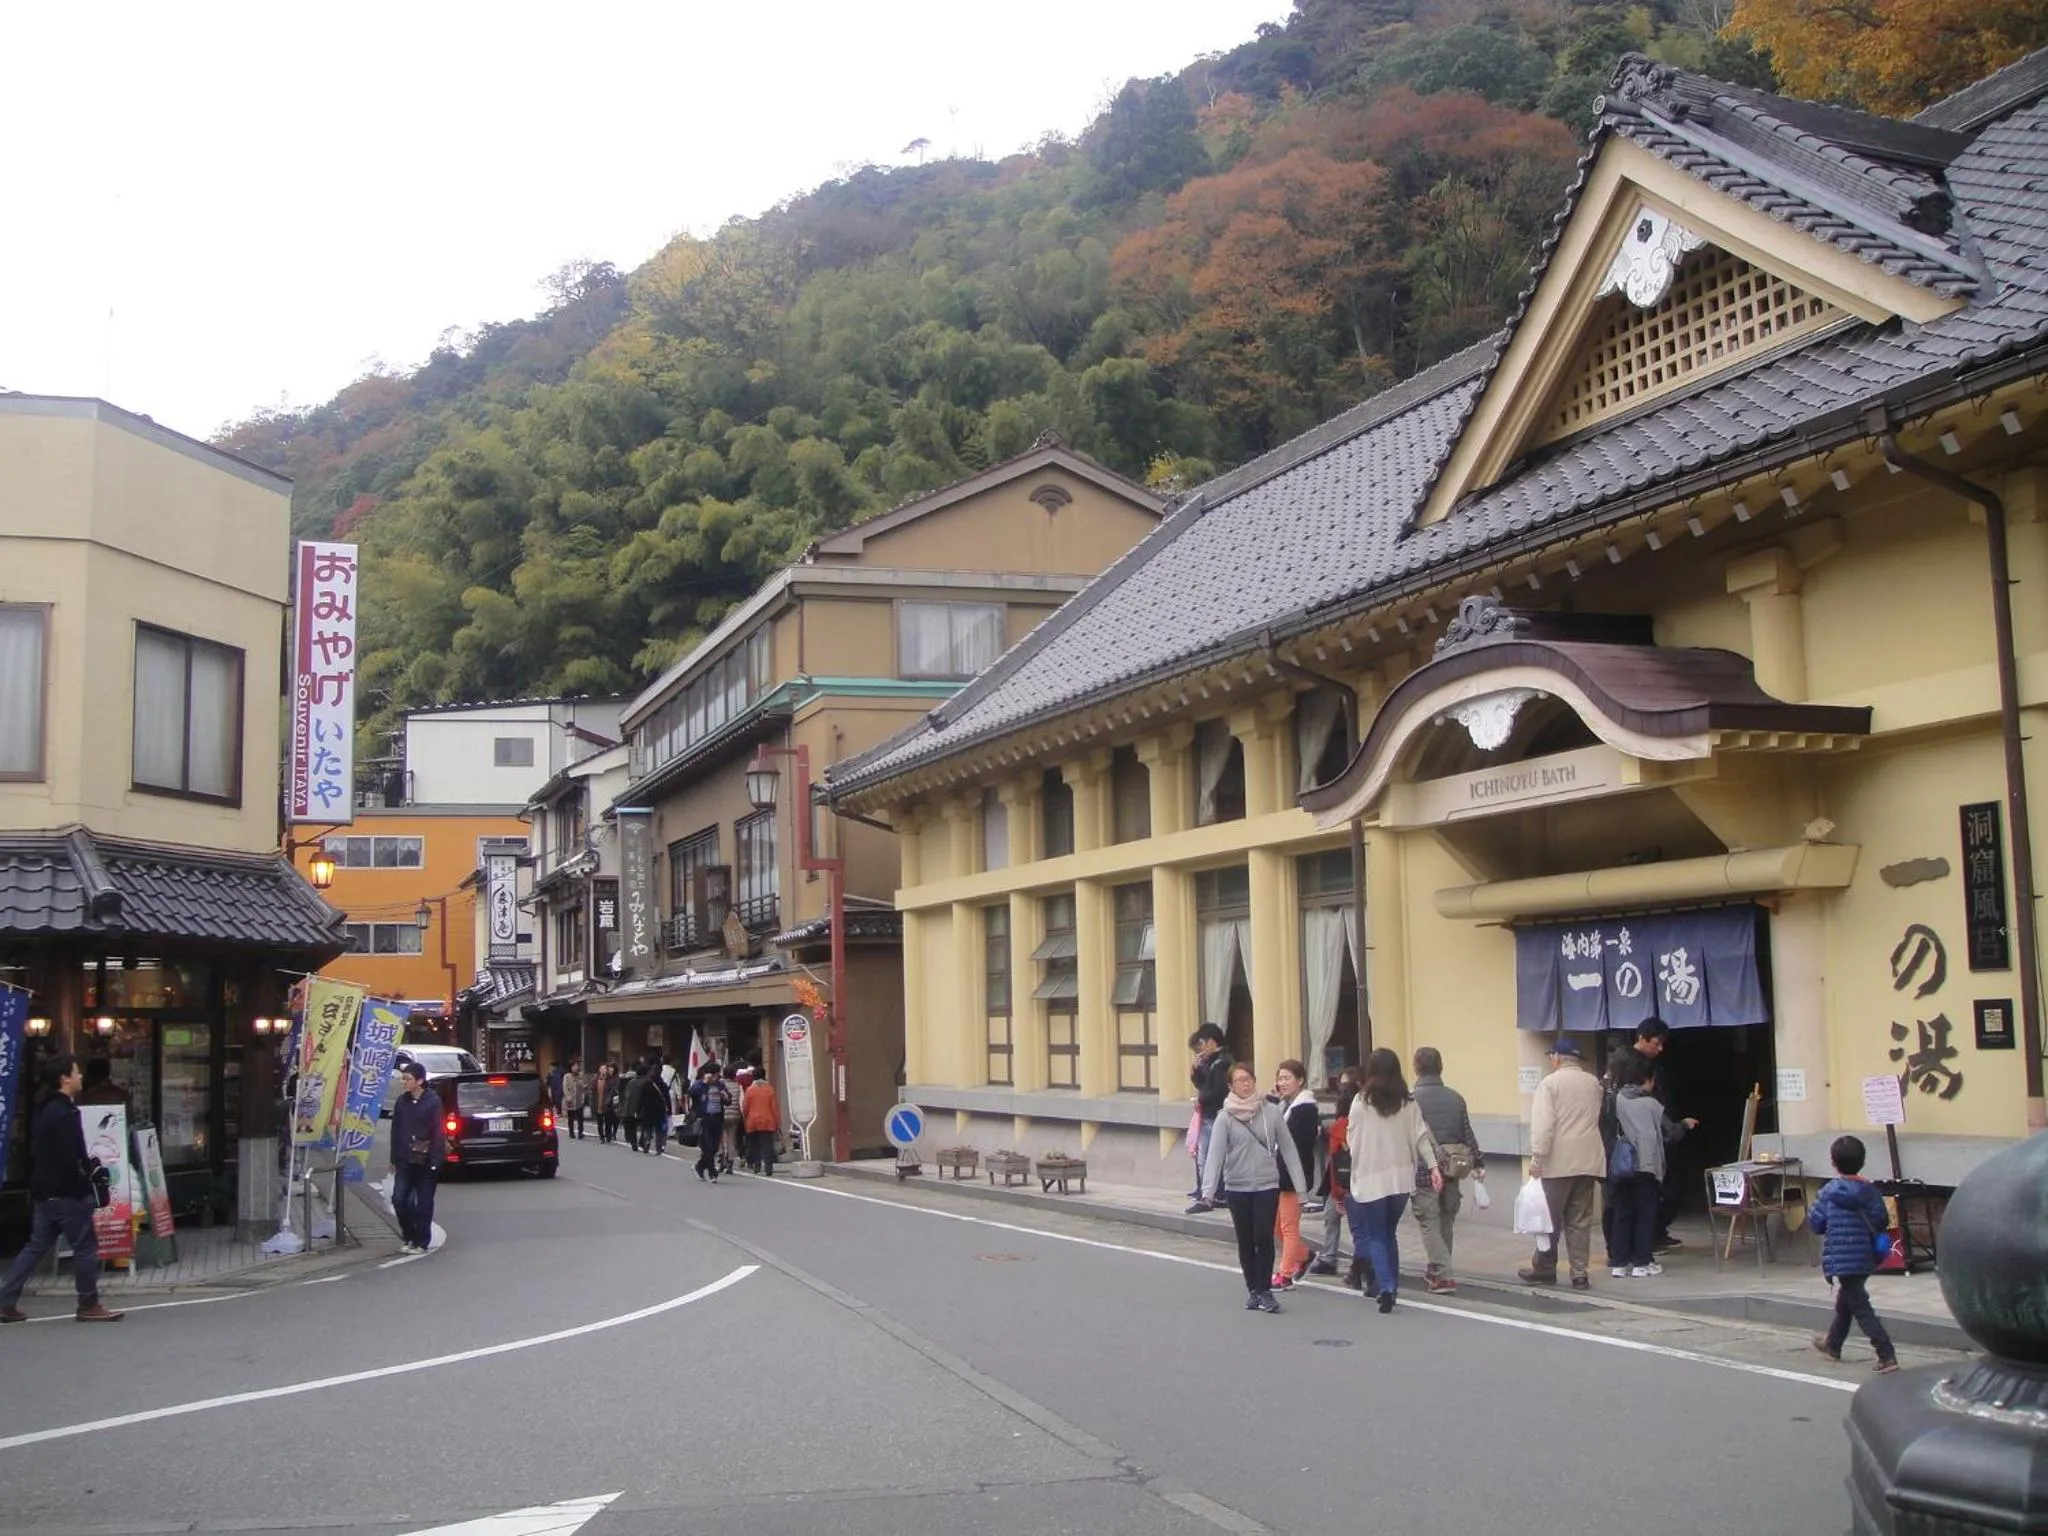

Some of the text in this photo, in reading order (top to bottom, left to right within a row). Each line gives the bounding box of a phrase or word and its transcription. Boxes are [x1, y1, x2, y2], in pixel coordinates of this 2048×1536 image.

[294, 673, 311, 808] Souvenir ITAYA
[310, 551, 357, 809] おみやげ いたや
[1470, 765, 1576, 799] ICHINOYU BATH
[1967, 809, 2000, 961] 洞窟風呂
[1567, 947, 1700, 1006] 一の湯
[1879, 856, 1964, 1101] 一の湯
[341, 1020, 398, 1148] 城崎ビール
